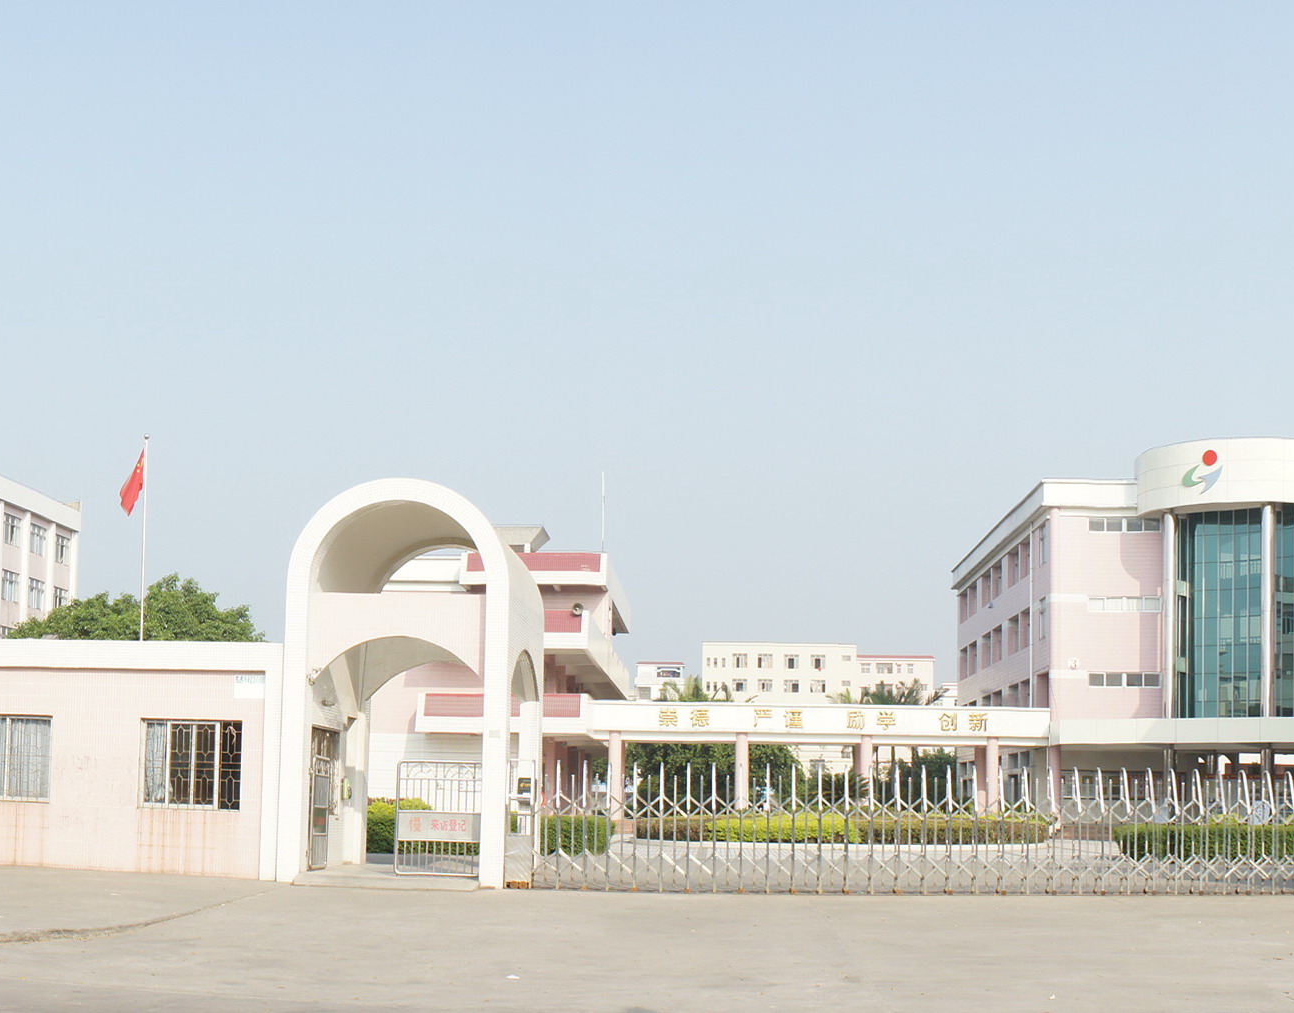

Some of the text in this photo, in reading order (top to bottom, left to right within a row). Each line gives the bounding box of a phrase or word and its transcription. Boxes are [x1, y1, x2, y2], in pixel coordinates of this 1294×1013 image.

[1070, 659, 1077, 670] 3
[659, 708, 988, 732] 崇德 严谨 励学 创新
[431, 819, 466, 831] 来访登记
